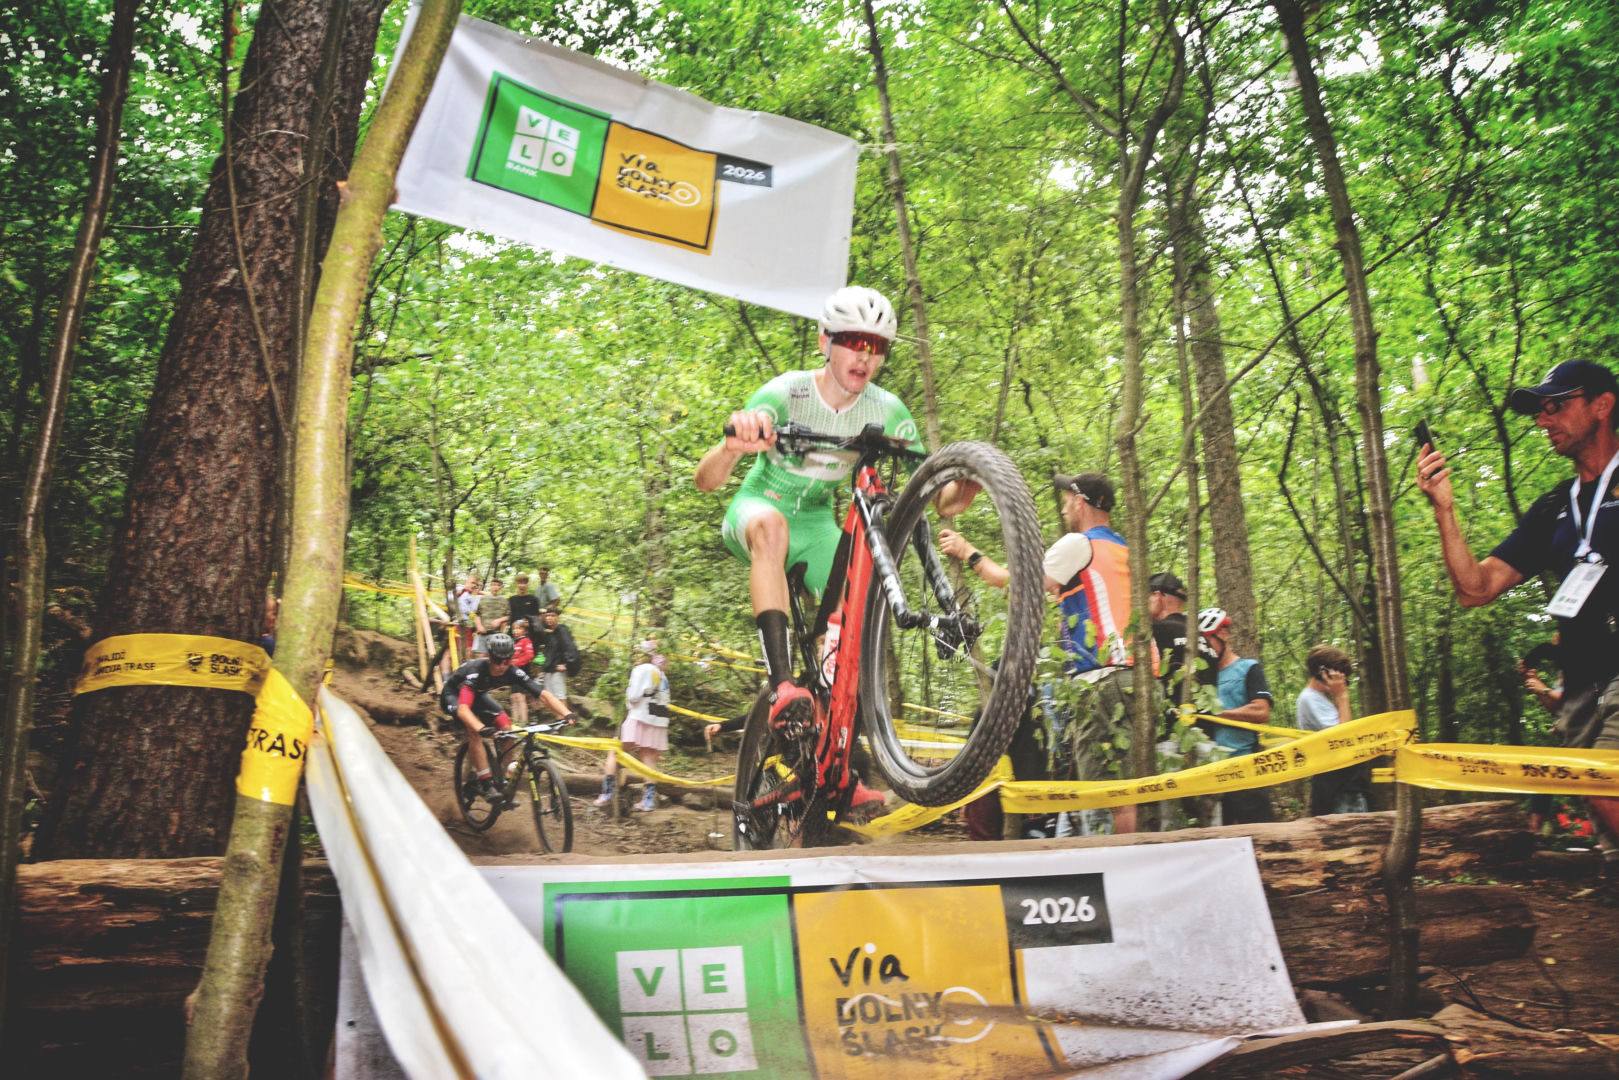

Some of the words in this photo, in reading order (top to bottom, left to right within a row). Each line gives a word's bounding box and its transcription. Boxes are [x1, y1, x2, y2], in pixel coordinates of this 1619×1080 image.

[723, 164, 766, 181] 2026
[1020, 896, 1096, 925] 2026
[835, 991, 944, 1027] DOLNY
